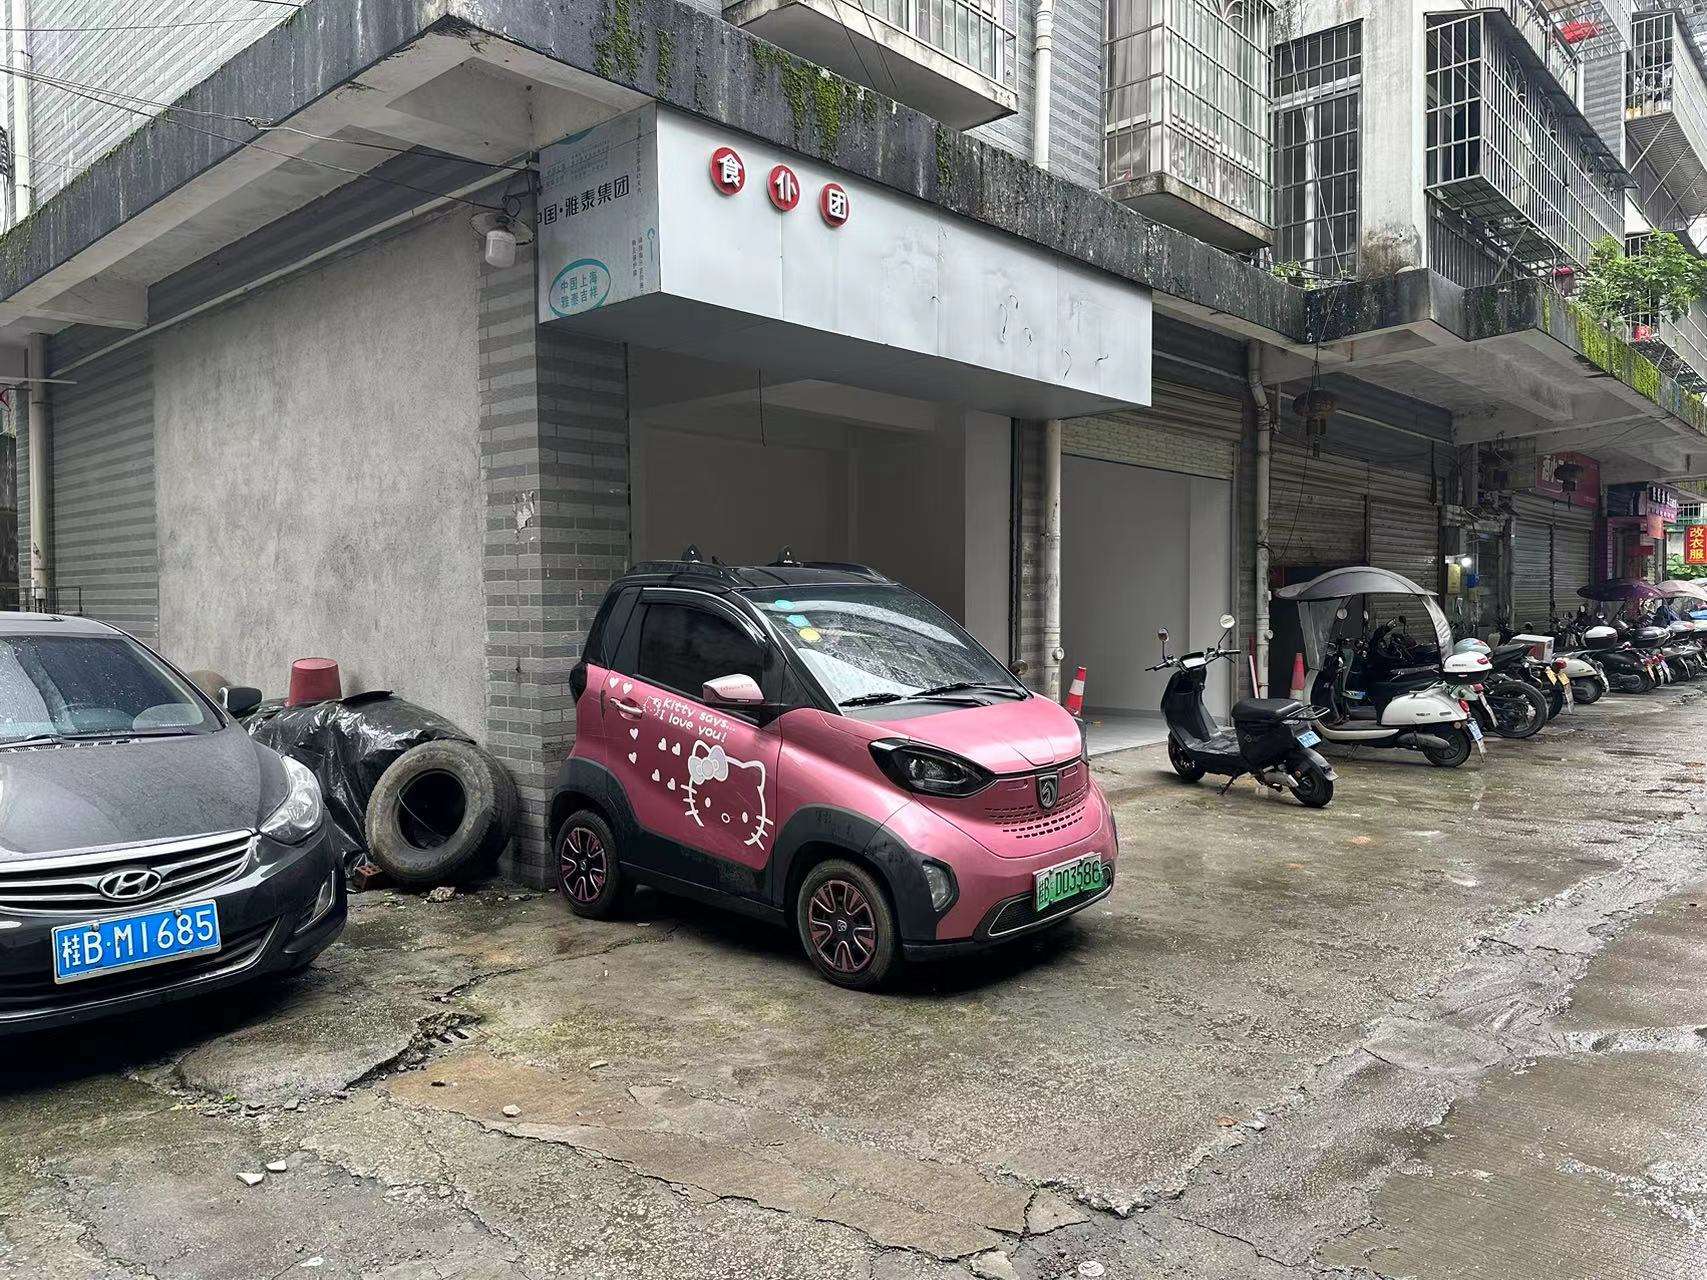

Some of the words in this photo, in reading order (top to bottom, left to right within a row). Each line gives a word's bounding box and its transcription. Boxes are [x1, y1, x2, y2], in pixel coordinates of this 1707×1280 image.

[561, 271, 597, 294] 中国上海
[1689, 527, 1704, 560] 改衣服
[668, 713, 693, 730] love
[698, 725, 727, 743] you!
